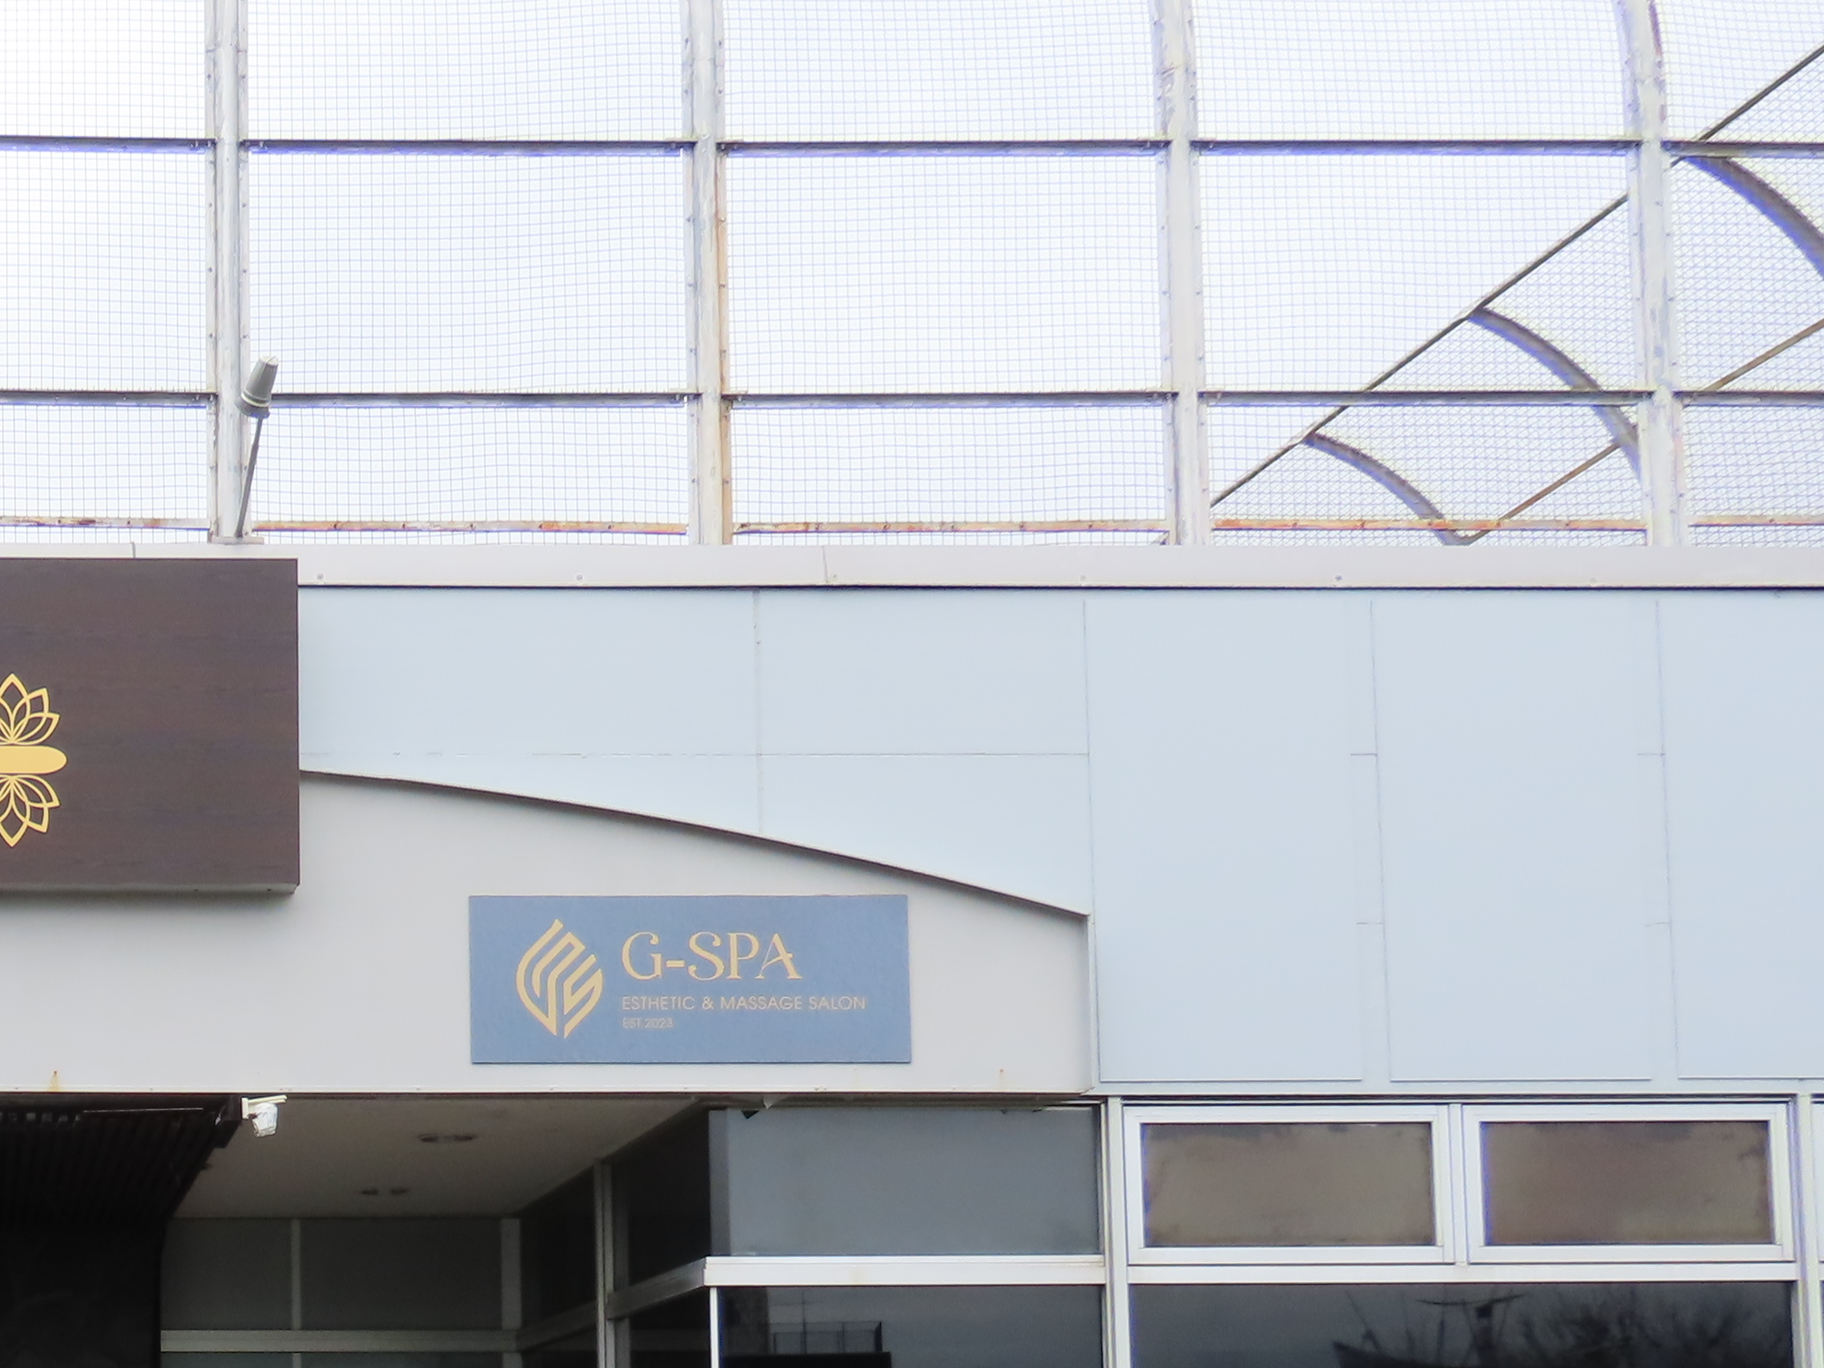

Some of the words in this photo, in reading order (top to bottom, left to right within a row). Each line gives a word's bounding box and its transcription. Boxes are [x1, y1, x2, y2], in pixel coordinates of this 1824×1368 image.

[620, 931, 803, 981] G-SPA
[622, 995, 696, 1011] ESTHETIC
[702, 995, 715, 1011] &
[719, 995, 803, 1011] MASSAGE
[808, 995, 867, 1011] SALON
[622, 1017, 643, 1029] EST
